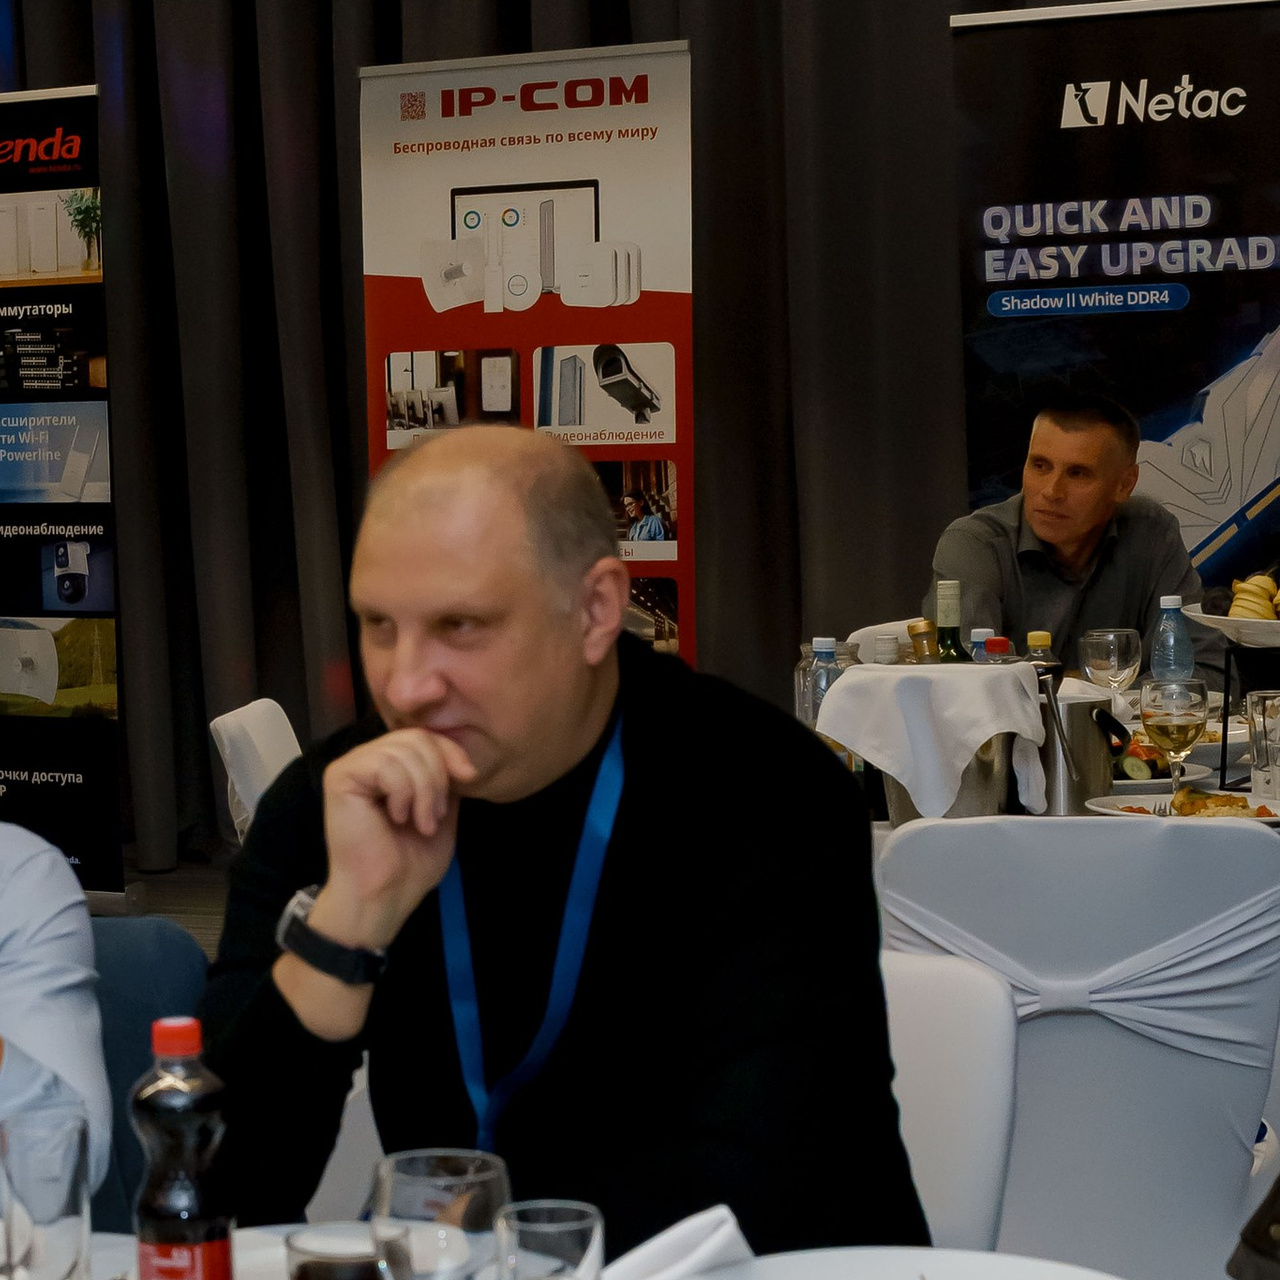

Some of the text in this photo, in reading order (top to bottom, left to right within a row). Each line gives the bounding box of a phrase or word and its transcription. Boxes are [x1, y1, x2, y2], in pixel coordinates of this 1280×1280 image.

[440, 74, 649, 118] IP-COM
[1117, 74, 1247, 125] Netac
[392, 124, 659, 156] Беспроводная связь по всему миру
[983, 195, 1212, 244] QUICK AND
[984, 236, 1277, 282] EASY UPGRAD
[1001, 294, 1064, 311] Shadow
[1079, 291, 1124, 307] White
[1127, 290, 1170, 305] DDR4
[18, 430, 50, 444] Wi-Fi
[0, 448, 61, 462] Powerline
[32, 770, 83, 786] доступа
